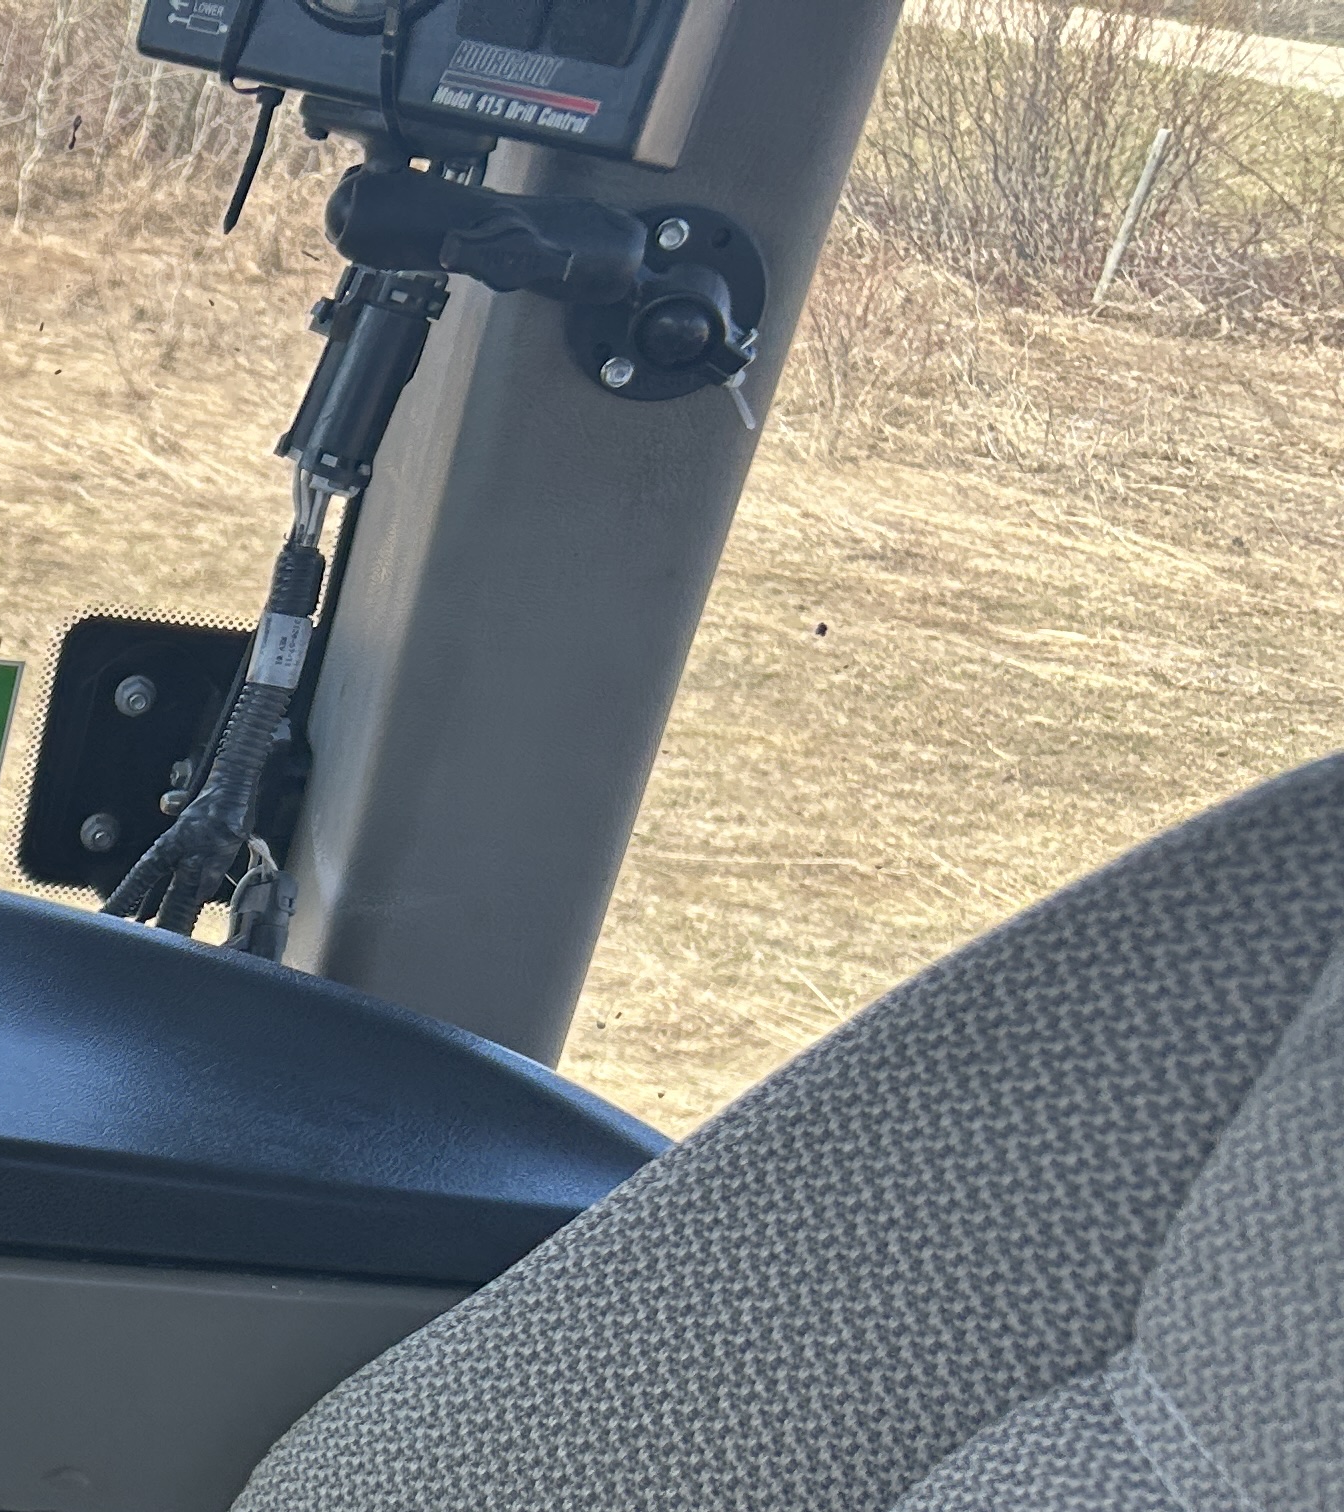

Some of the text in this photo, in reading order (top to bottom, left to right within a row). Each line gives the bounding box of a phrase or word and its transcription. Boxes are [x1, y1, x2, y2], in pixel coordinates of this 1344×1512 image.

[193, 1, 225, 17] LOWER
[432, 85, 590, 134] Model 415 Drill Control
